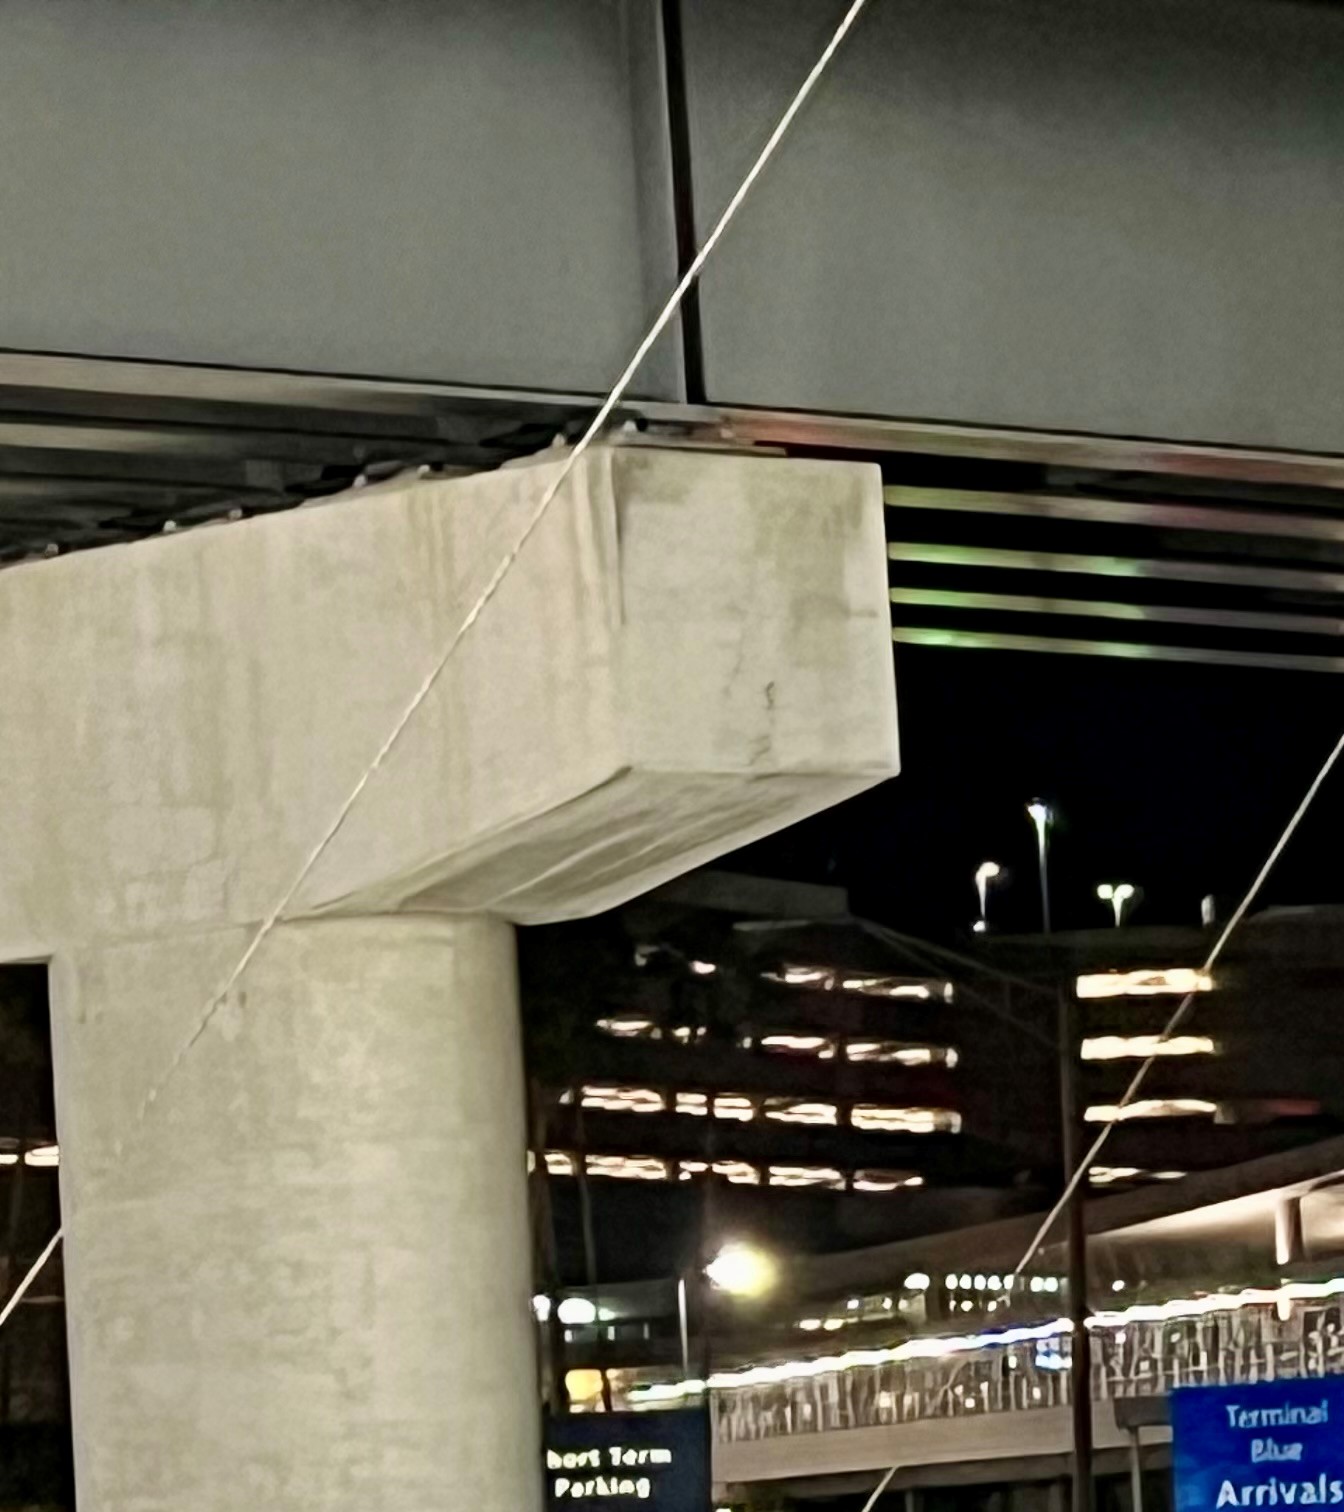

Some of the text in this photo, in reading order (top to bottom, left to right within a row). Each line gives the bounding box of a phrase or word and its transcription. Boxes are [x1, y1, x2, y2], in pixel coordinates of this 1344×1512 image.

[1225, 1398, 1329, 1429] Terminal
[546, 1446, 672, 1470] hort Term
[1251, 1436, 1303, 1463] Blue
[554, 1475, 651, 1499] Parking
[1215, 1472, 1344, 1510] Arrivals
